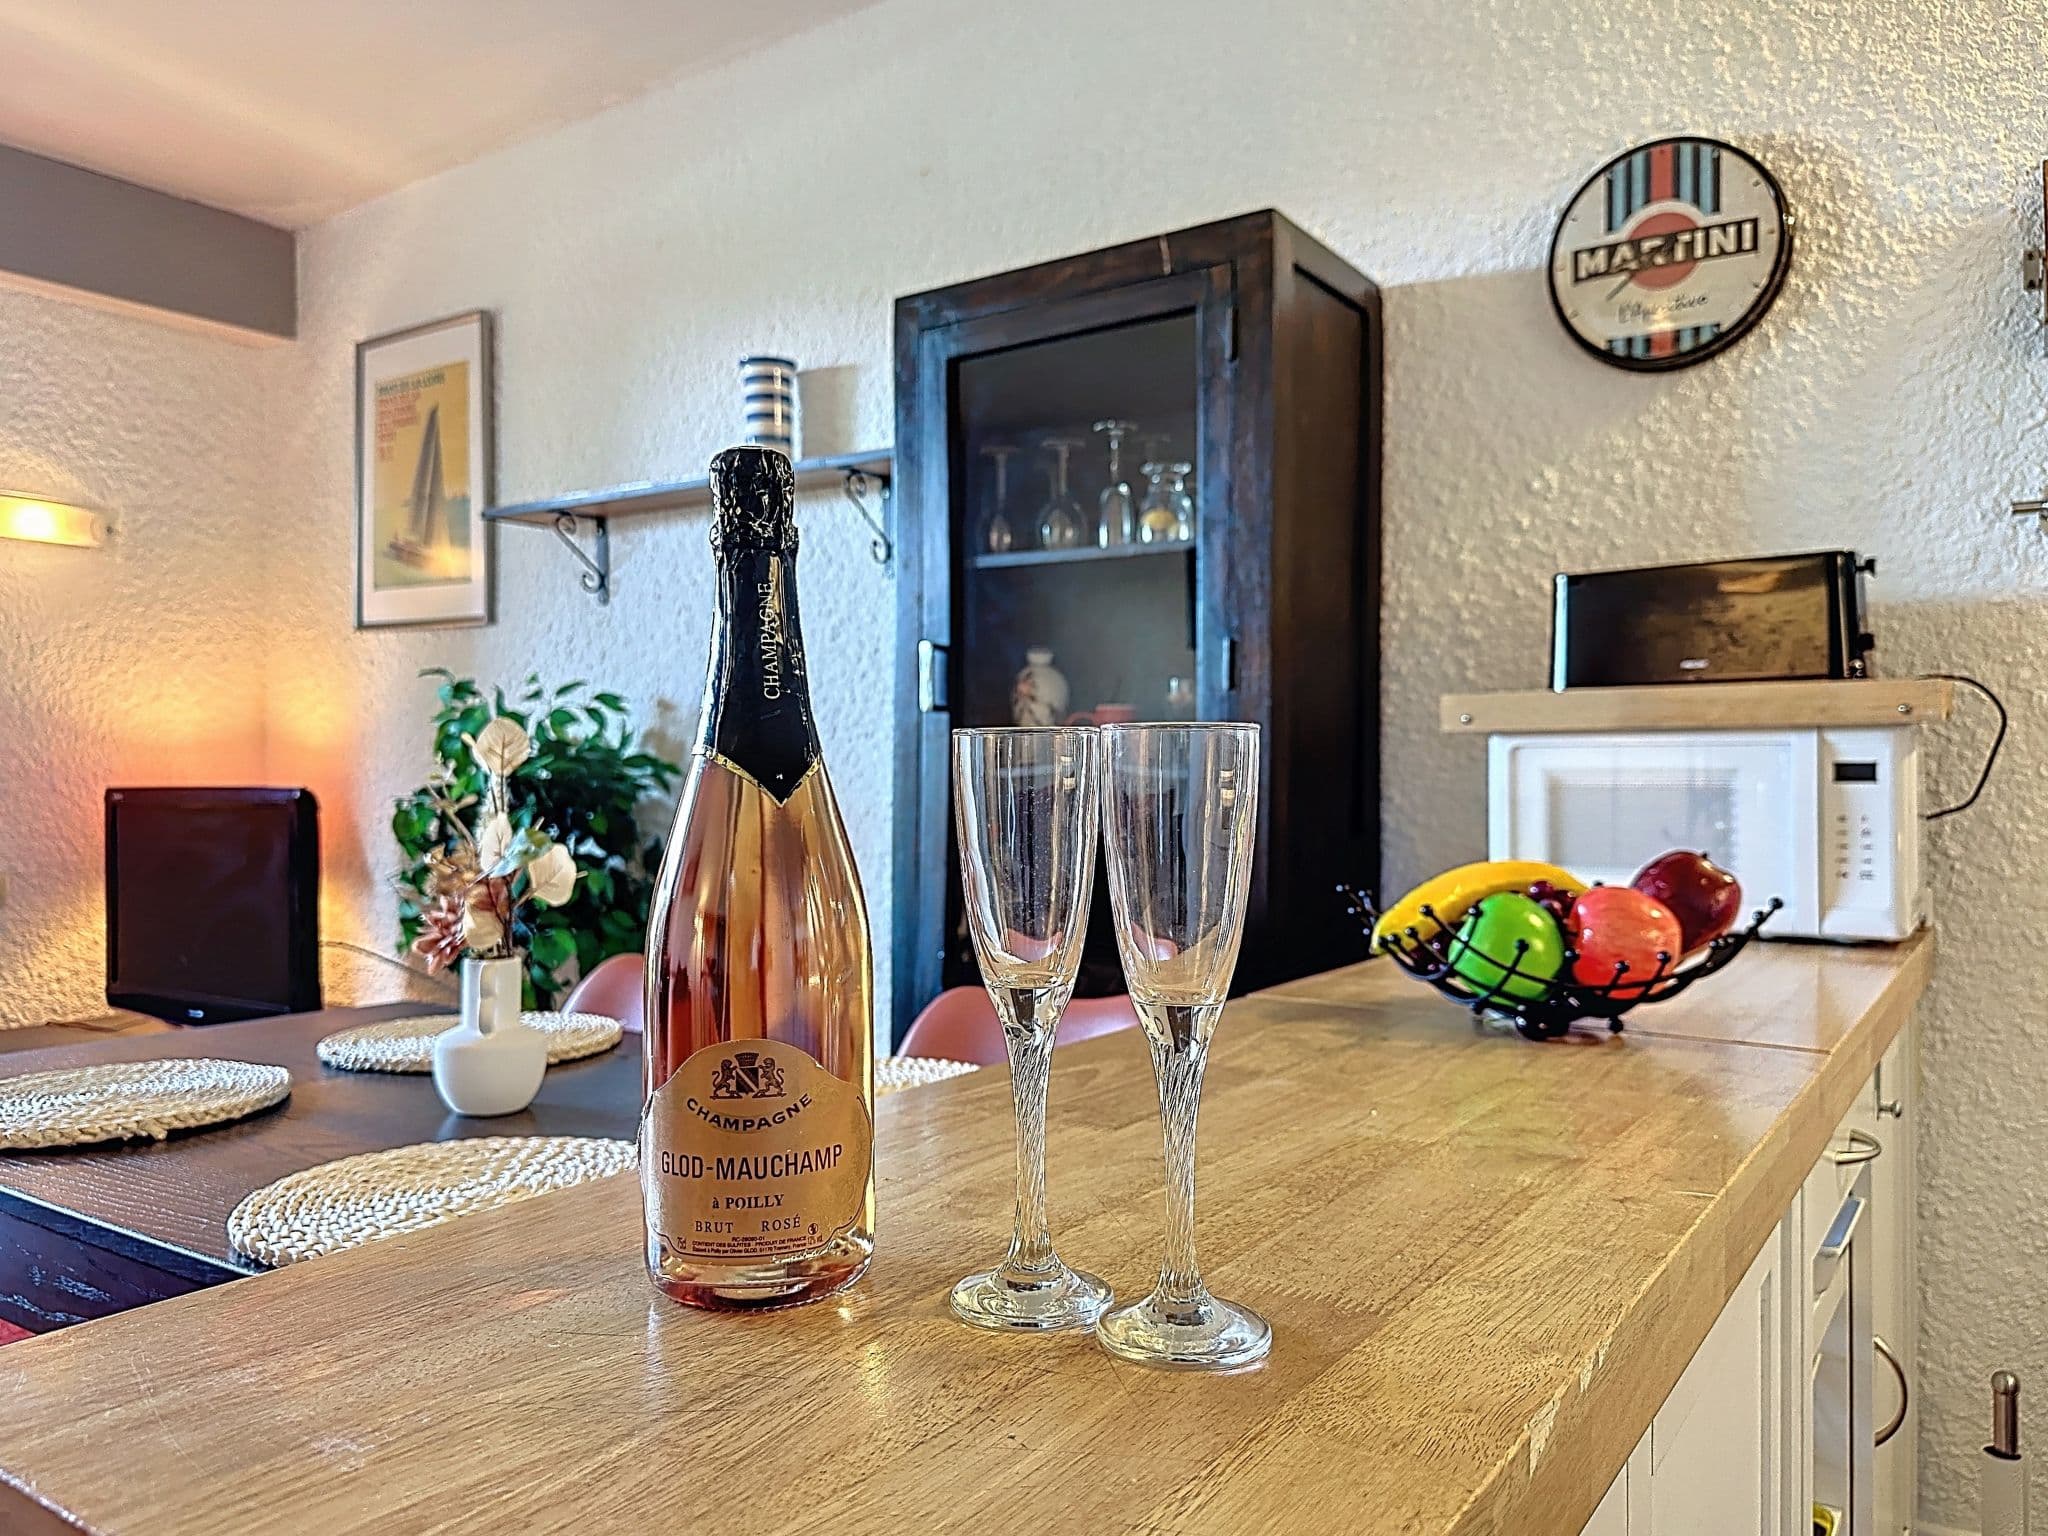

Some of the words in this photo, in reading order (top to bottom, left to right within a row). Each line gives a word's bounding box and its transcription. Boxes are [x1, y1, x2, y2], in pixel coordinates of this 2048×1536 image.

[1576, 220, 1756, 280] MARTINI
[758, 583, 781, 699] CHAMPAGNE
[687, 1093, 812, 1131] CHAMPAGNE
[661, 1144, 842, 1181] GLOD-MAUCHAMP
[712, 1197, 720, 1209] à
[725, 1194, 784, 1210] POILLY
[695, 1220, 734, 1233] BRUT
[761, 1214, 801, 1232] ROSÉ
